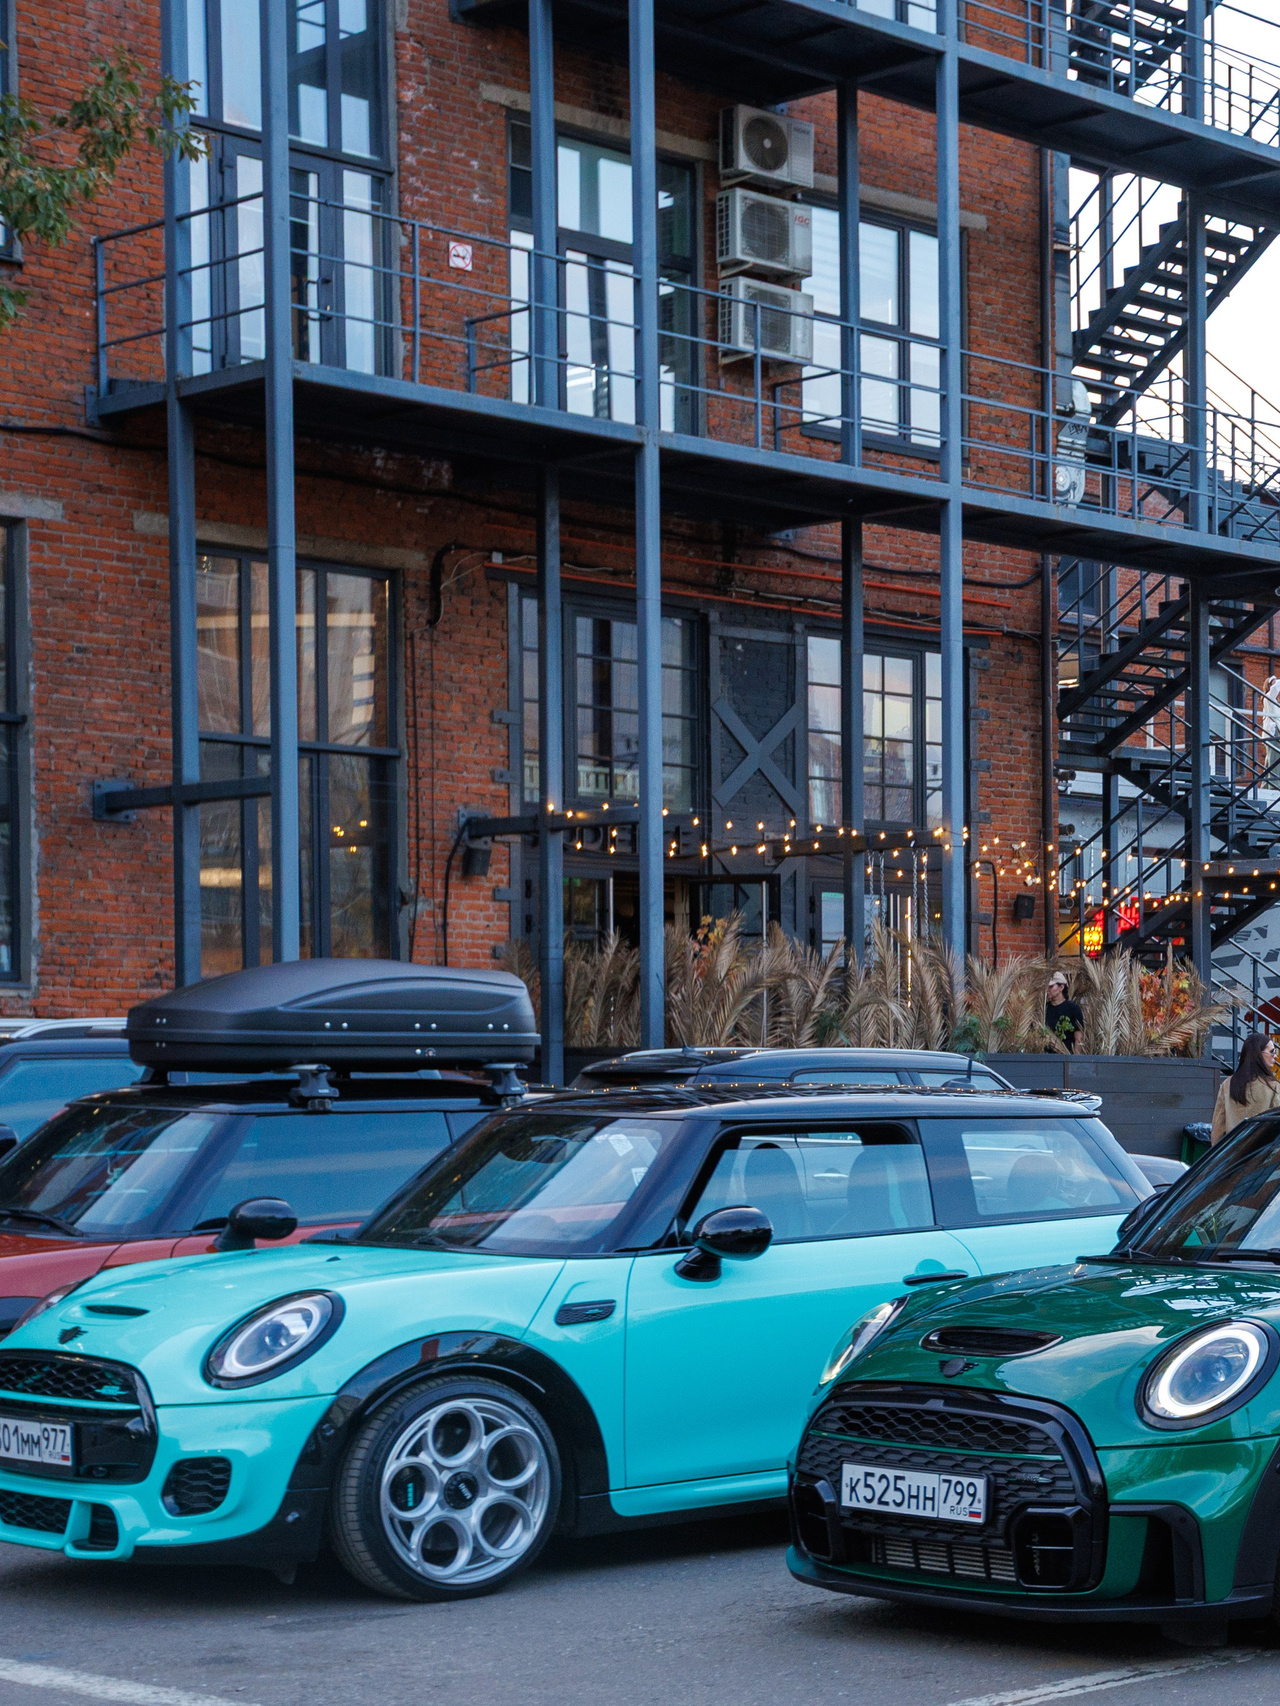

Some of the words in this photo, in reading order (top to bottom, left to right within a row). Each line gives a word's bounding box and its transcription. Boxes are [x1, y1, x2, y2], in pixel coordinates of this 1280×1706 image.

[0, 1424, 41, 1457] 01ММ
[42, 1427, 66, 1452] 977
[942, 1478, 977, 1507] 799
[949, 1505, 968, 1517] RUS
